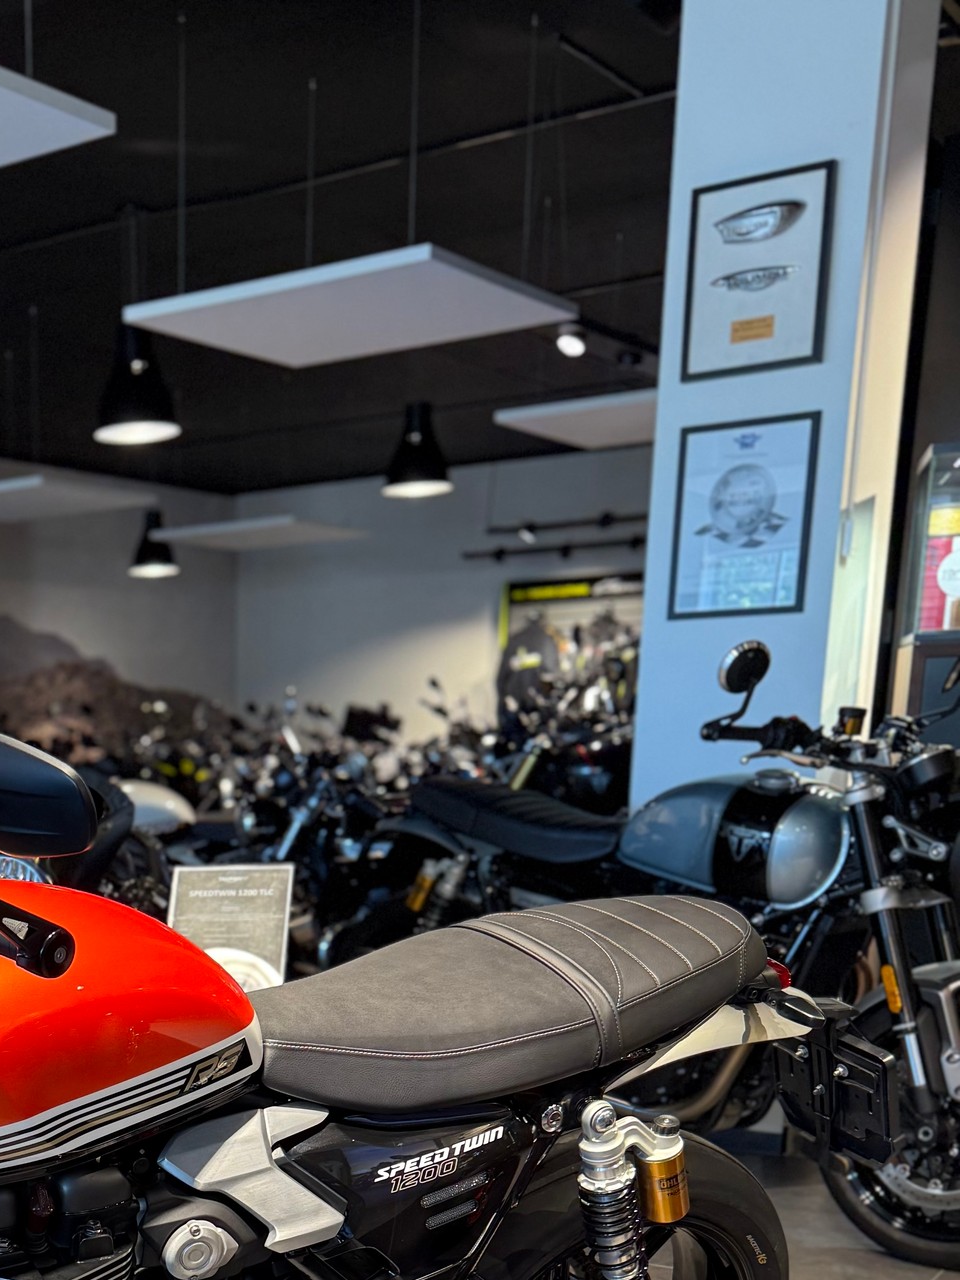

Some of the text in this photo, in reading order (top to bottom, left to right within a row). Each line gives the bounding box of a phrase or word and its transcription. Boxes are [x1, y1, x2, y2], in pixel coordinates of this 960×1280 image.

[374, 1126, 504, 1183] SPEED TWIN
[390, 1157, 459, 1194] 1200
